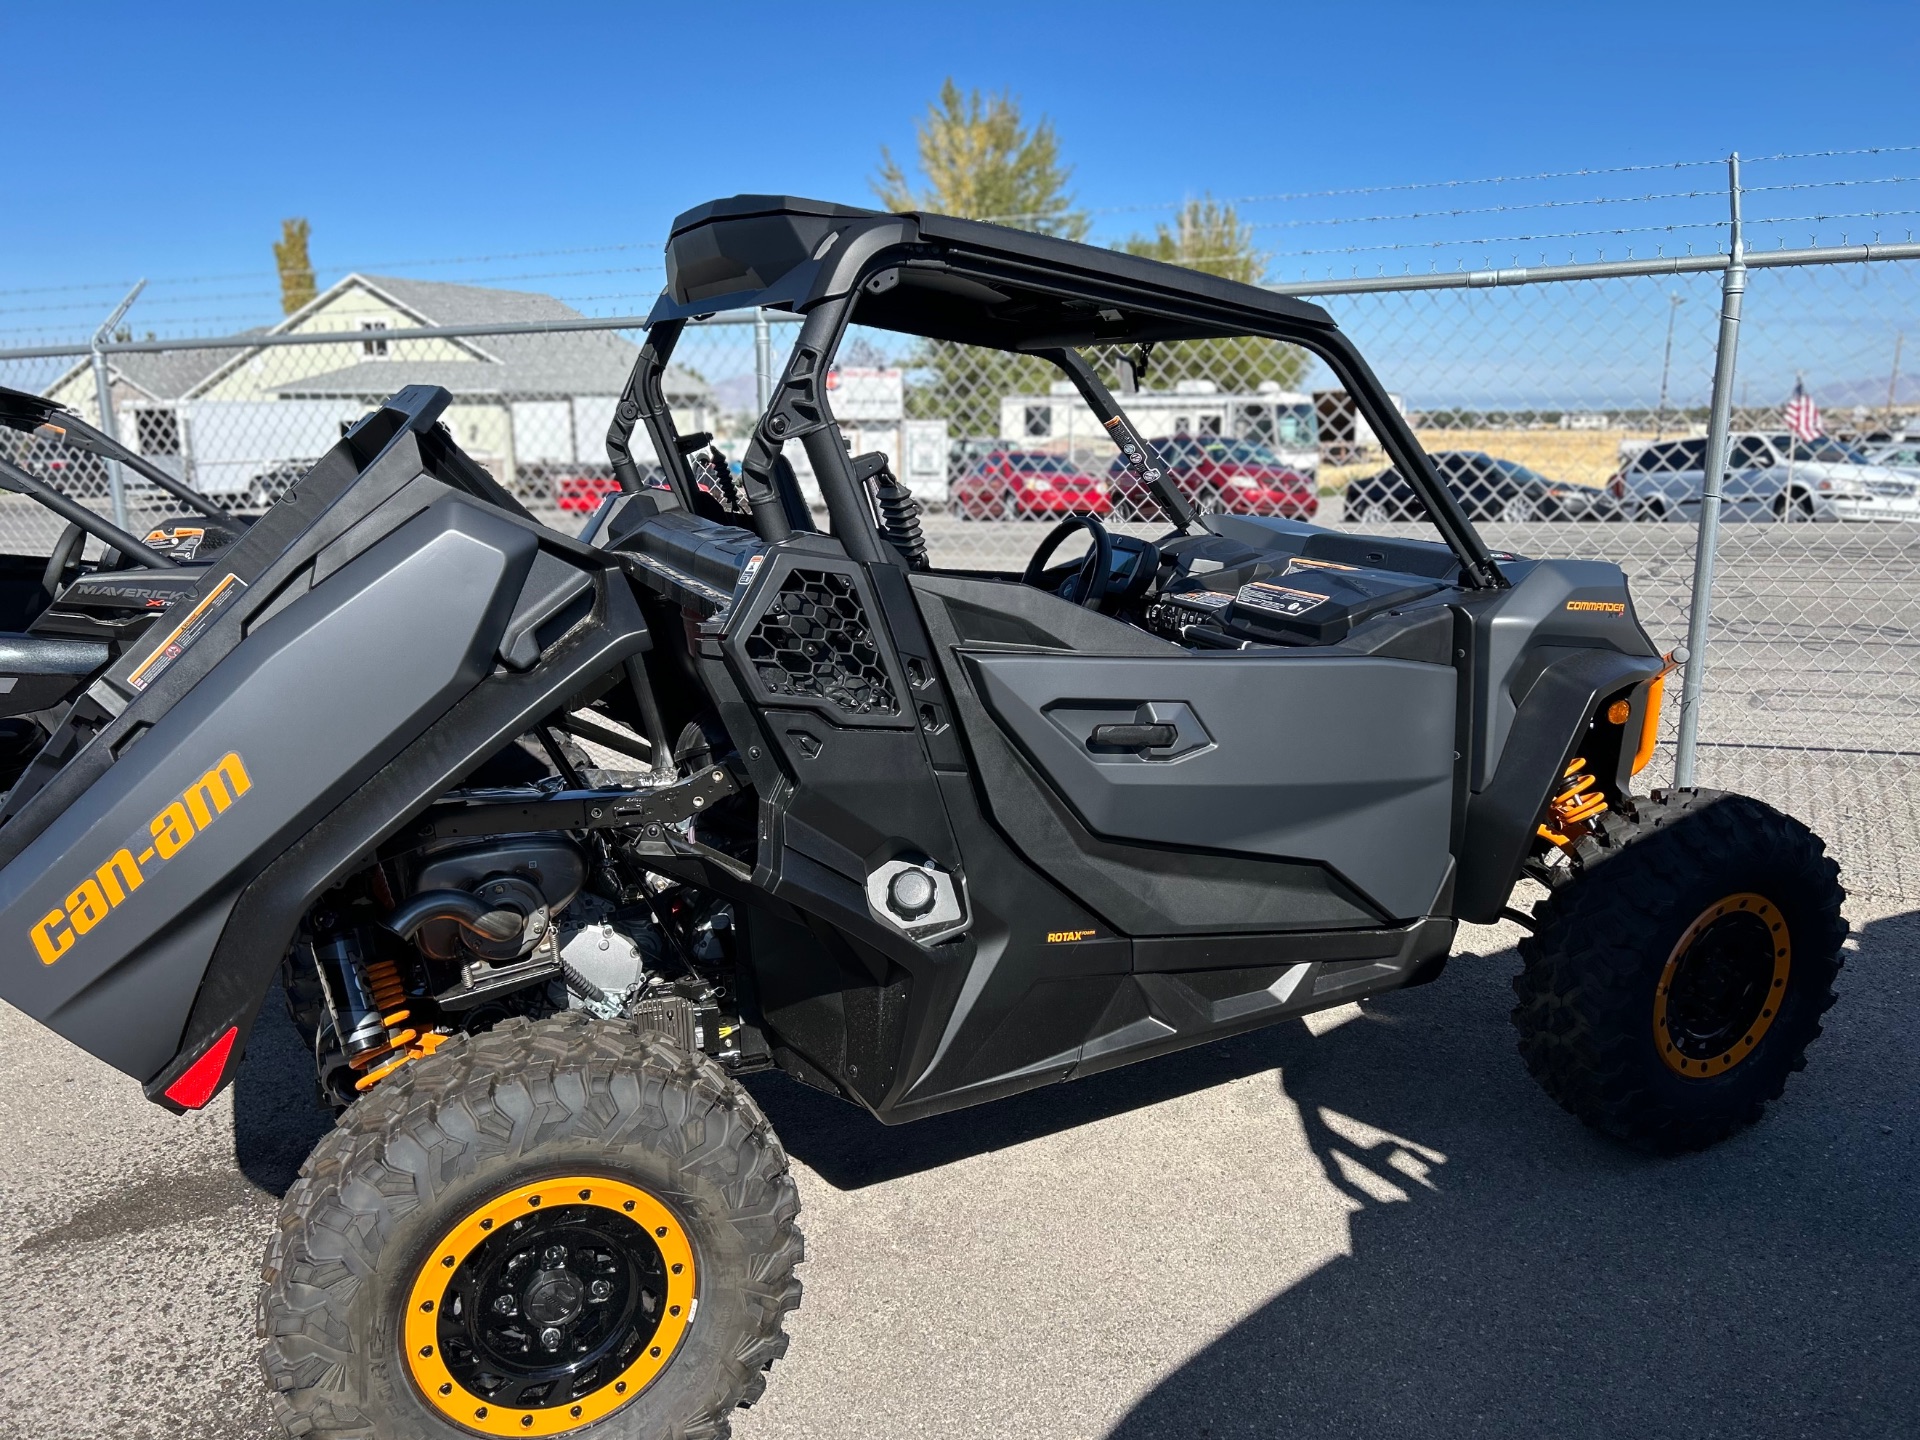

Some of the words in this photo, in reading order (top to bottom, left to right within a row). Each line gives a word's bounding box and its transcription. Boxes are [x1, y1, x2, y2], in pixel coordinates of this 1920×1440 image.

[77, 584, 184, 600] MAVERICK
[1566, 601, 1625, 613] COMMANDER
[30, 752, 252, 965] can-am
[1047, 931, 1082, 943] ROTAX
